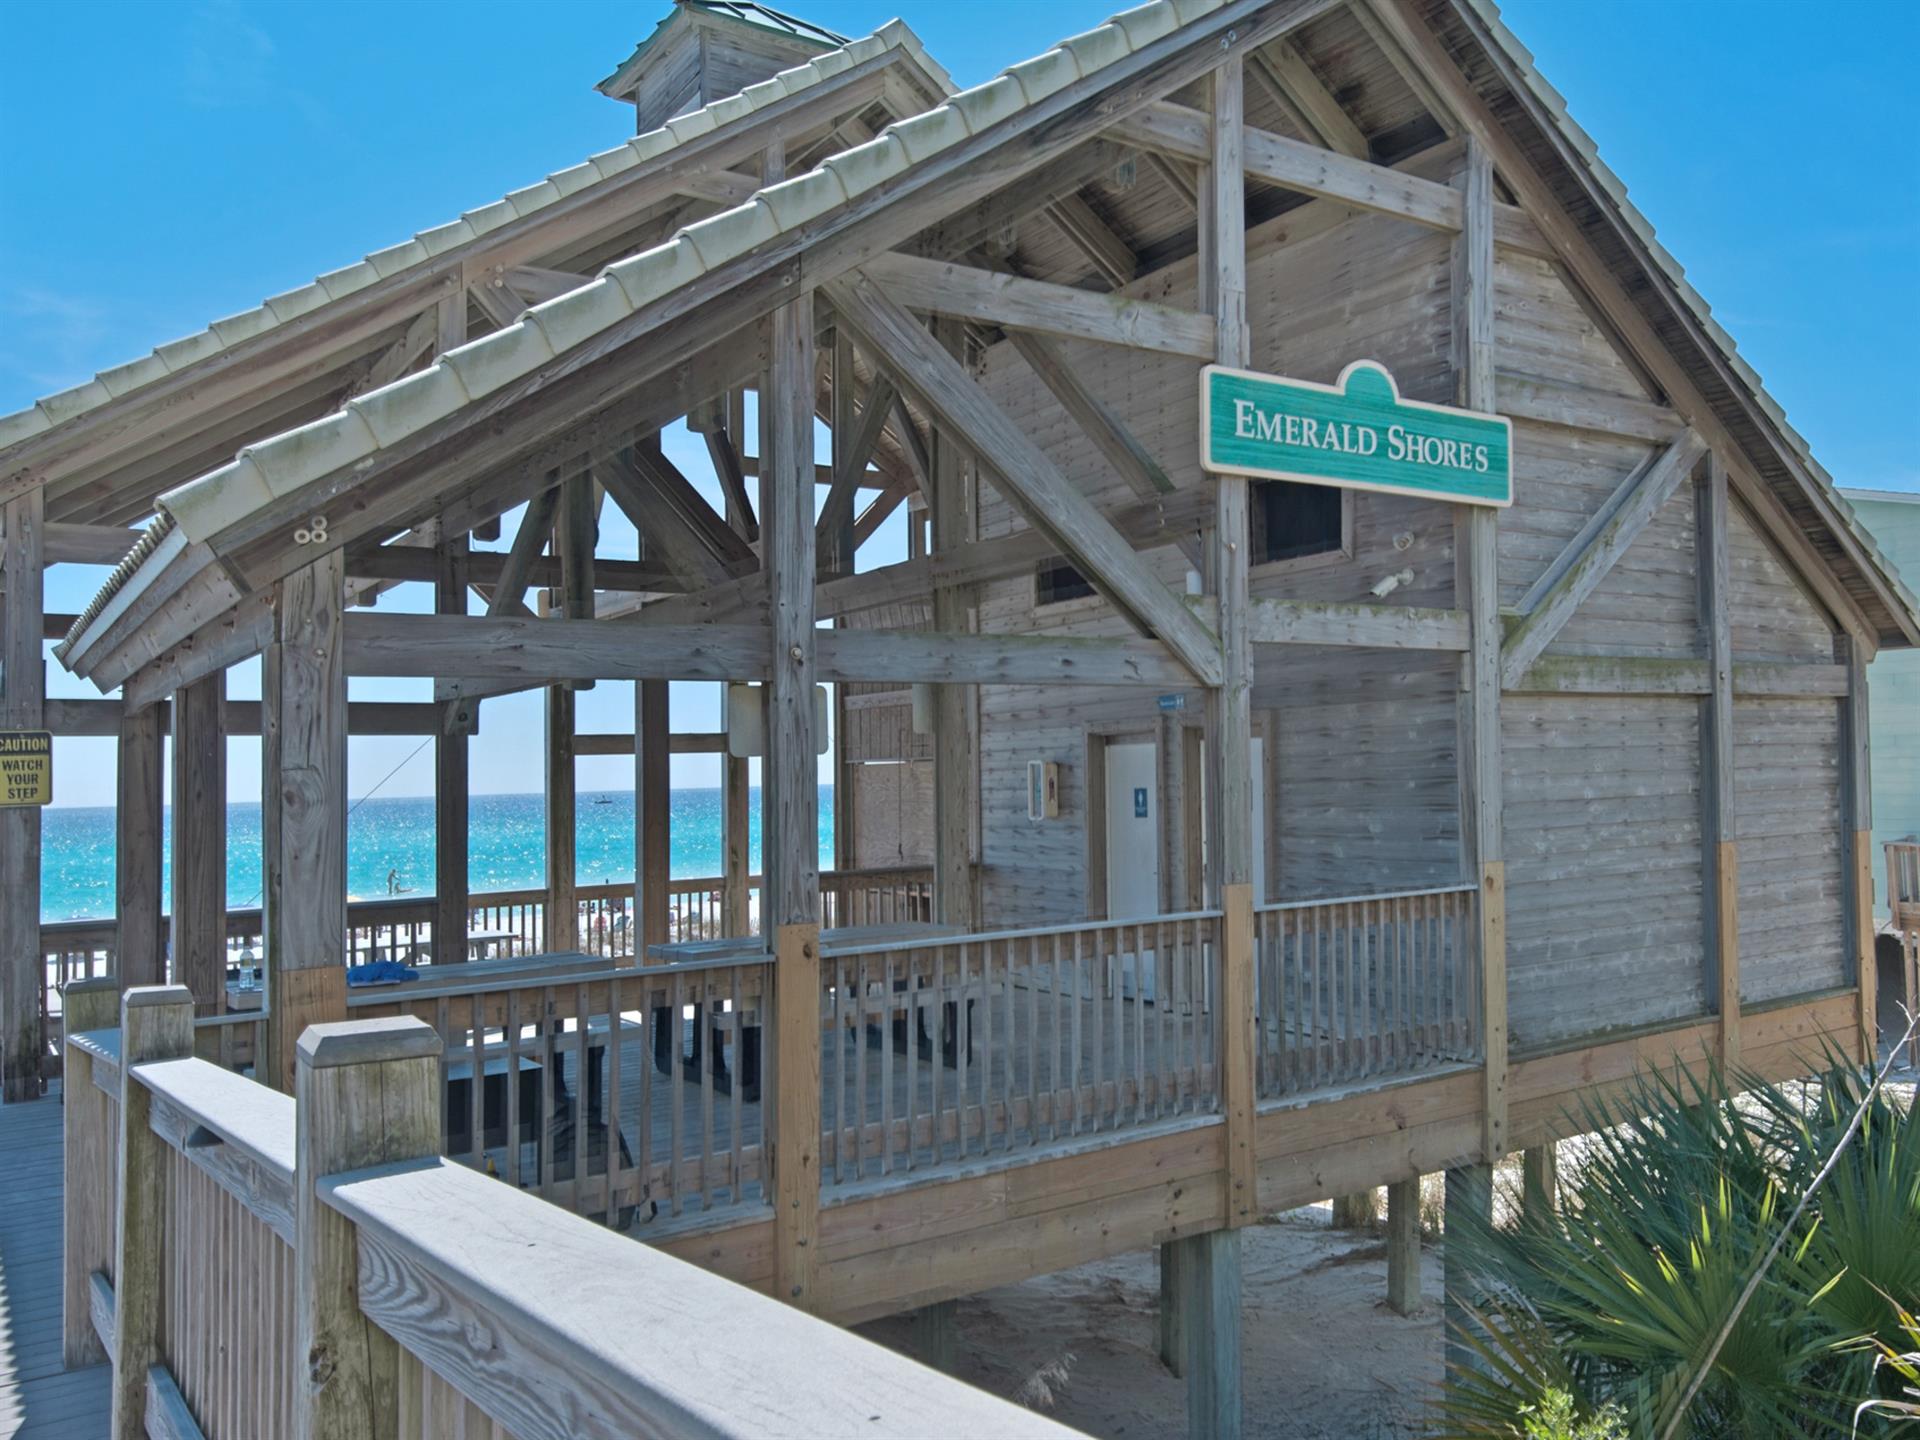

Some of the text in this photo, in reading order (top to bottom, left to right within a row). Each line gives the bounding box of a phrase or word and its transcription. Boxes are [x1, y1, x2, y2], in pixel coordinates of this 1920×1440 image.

[1233, 399, 1489, 472] EMERALD SHORES
[0, 738, 48, 751] CAUTION
[2, 760, 43, 771] WATCH
[7, 773, 39, 785] YOUR
[8, 788, 38, 799] STEP
